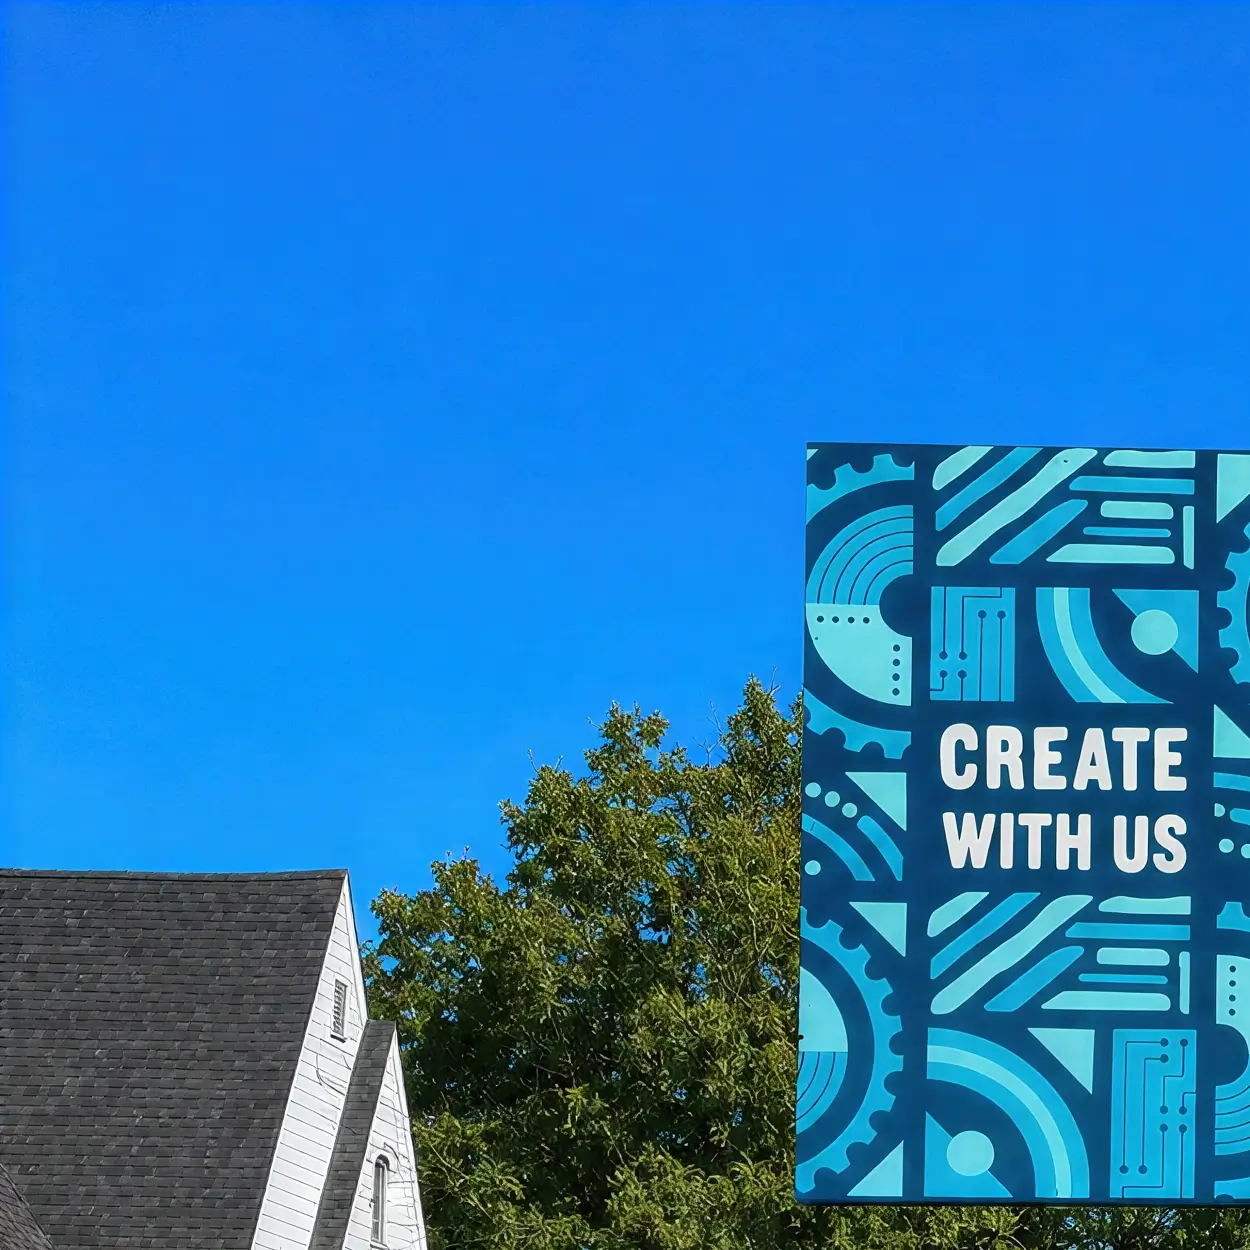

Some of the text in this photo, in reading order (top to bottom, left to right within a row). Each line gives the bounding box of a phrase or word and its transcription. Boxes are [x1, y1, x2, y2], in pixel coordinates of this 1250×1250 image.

[939, 723, 1188, 791] CREATE
[942, 811, 1188, 874] WITH US
